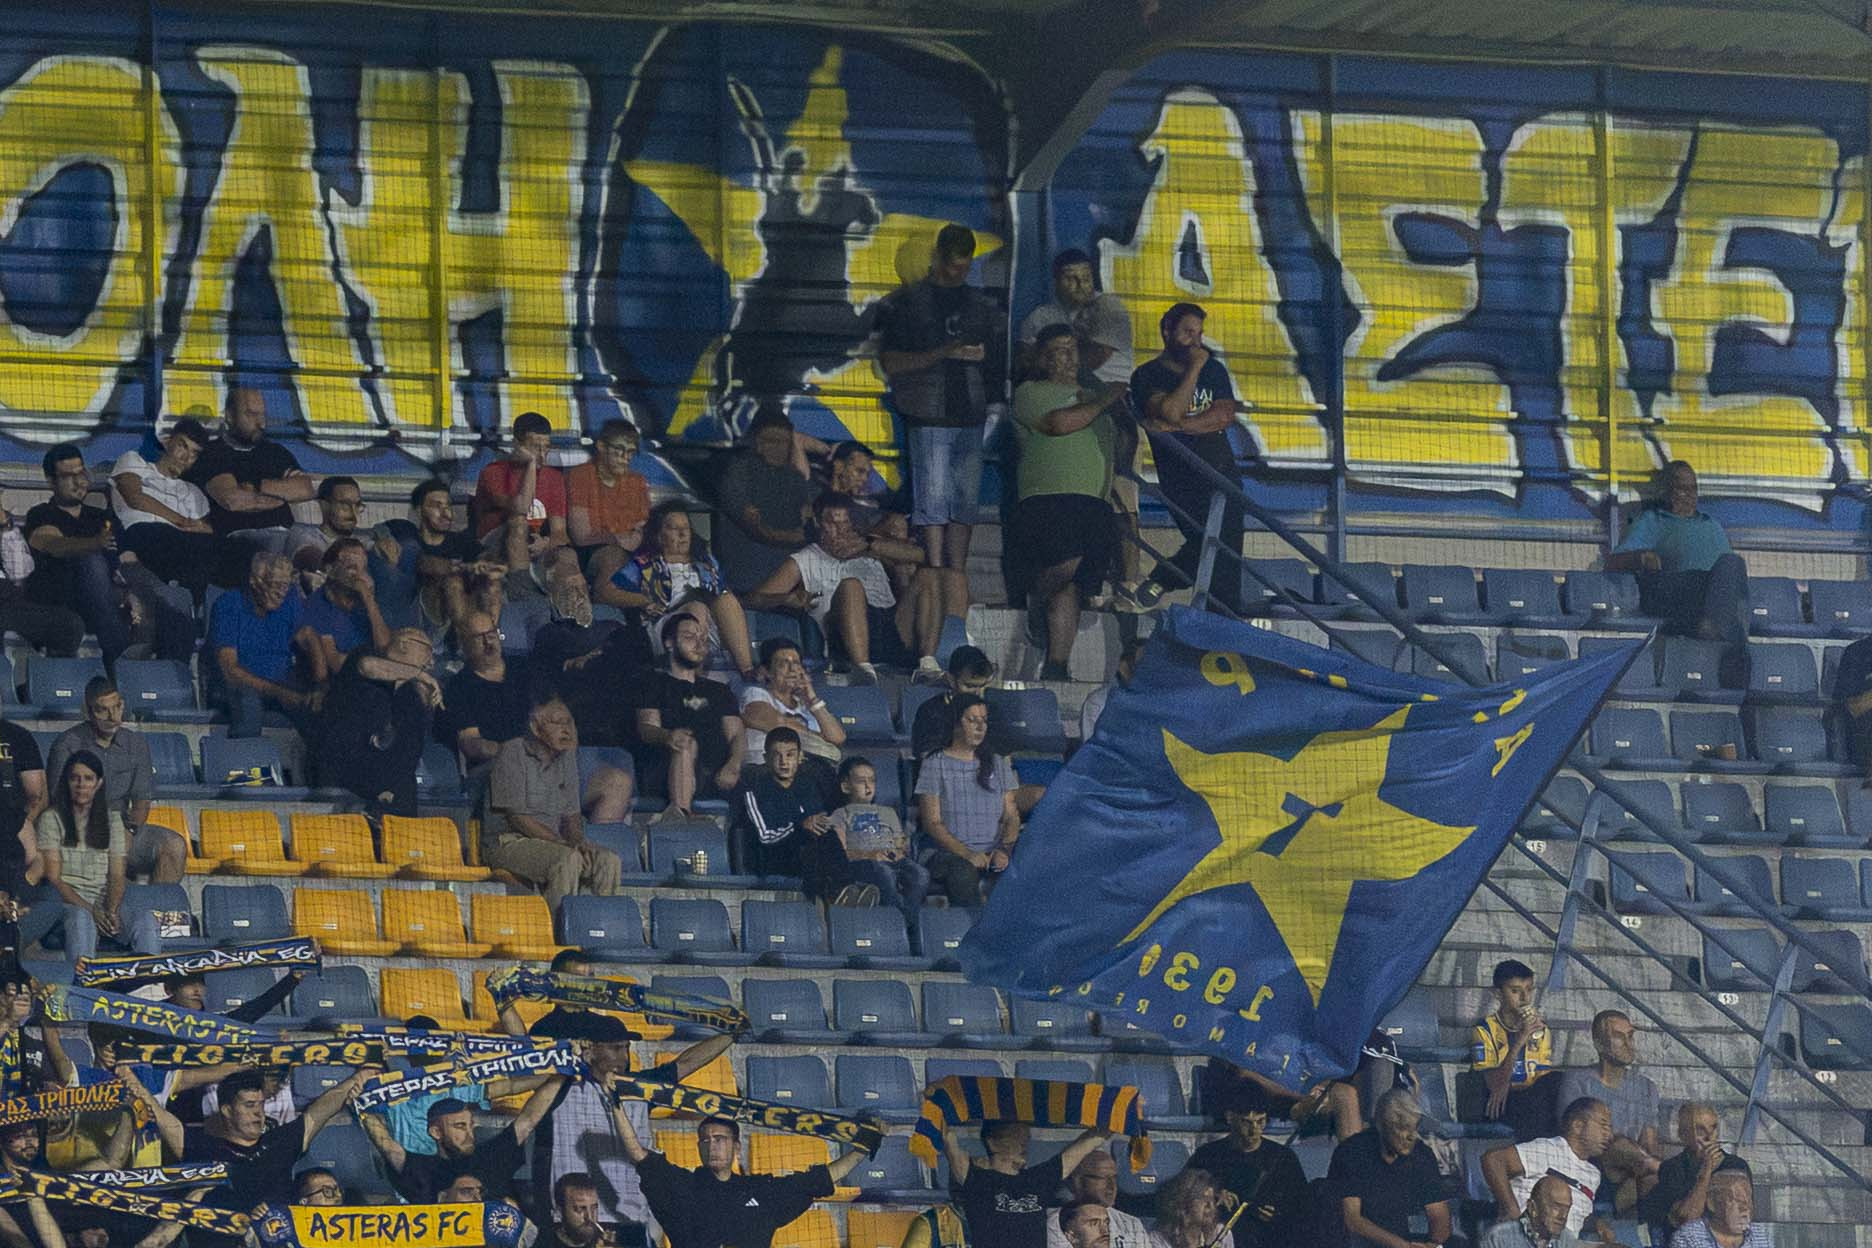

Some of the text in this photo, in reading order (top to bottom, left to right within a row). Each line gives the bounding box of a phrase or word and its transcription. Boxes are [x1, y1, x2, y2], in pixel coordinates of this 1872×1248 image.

[1096, 84, 1872, 514] ΑΣΤΕ
[139, 1041, 371, 1068] TIGERS
[310, 1209, 472, 1242] ASTERAS FC
